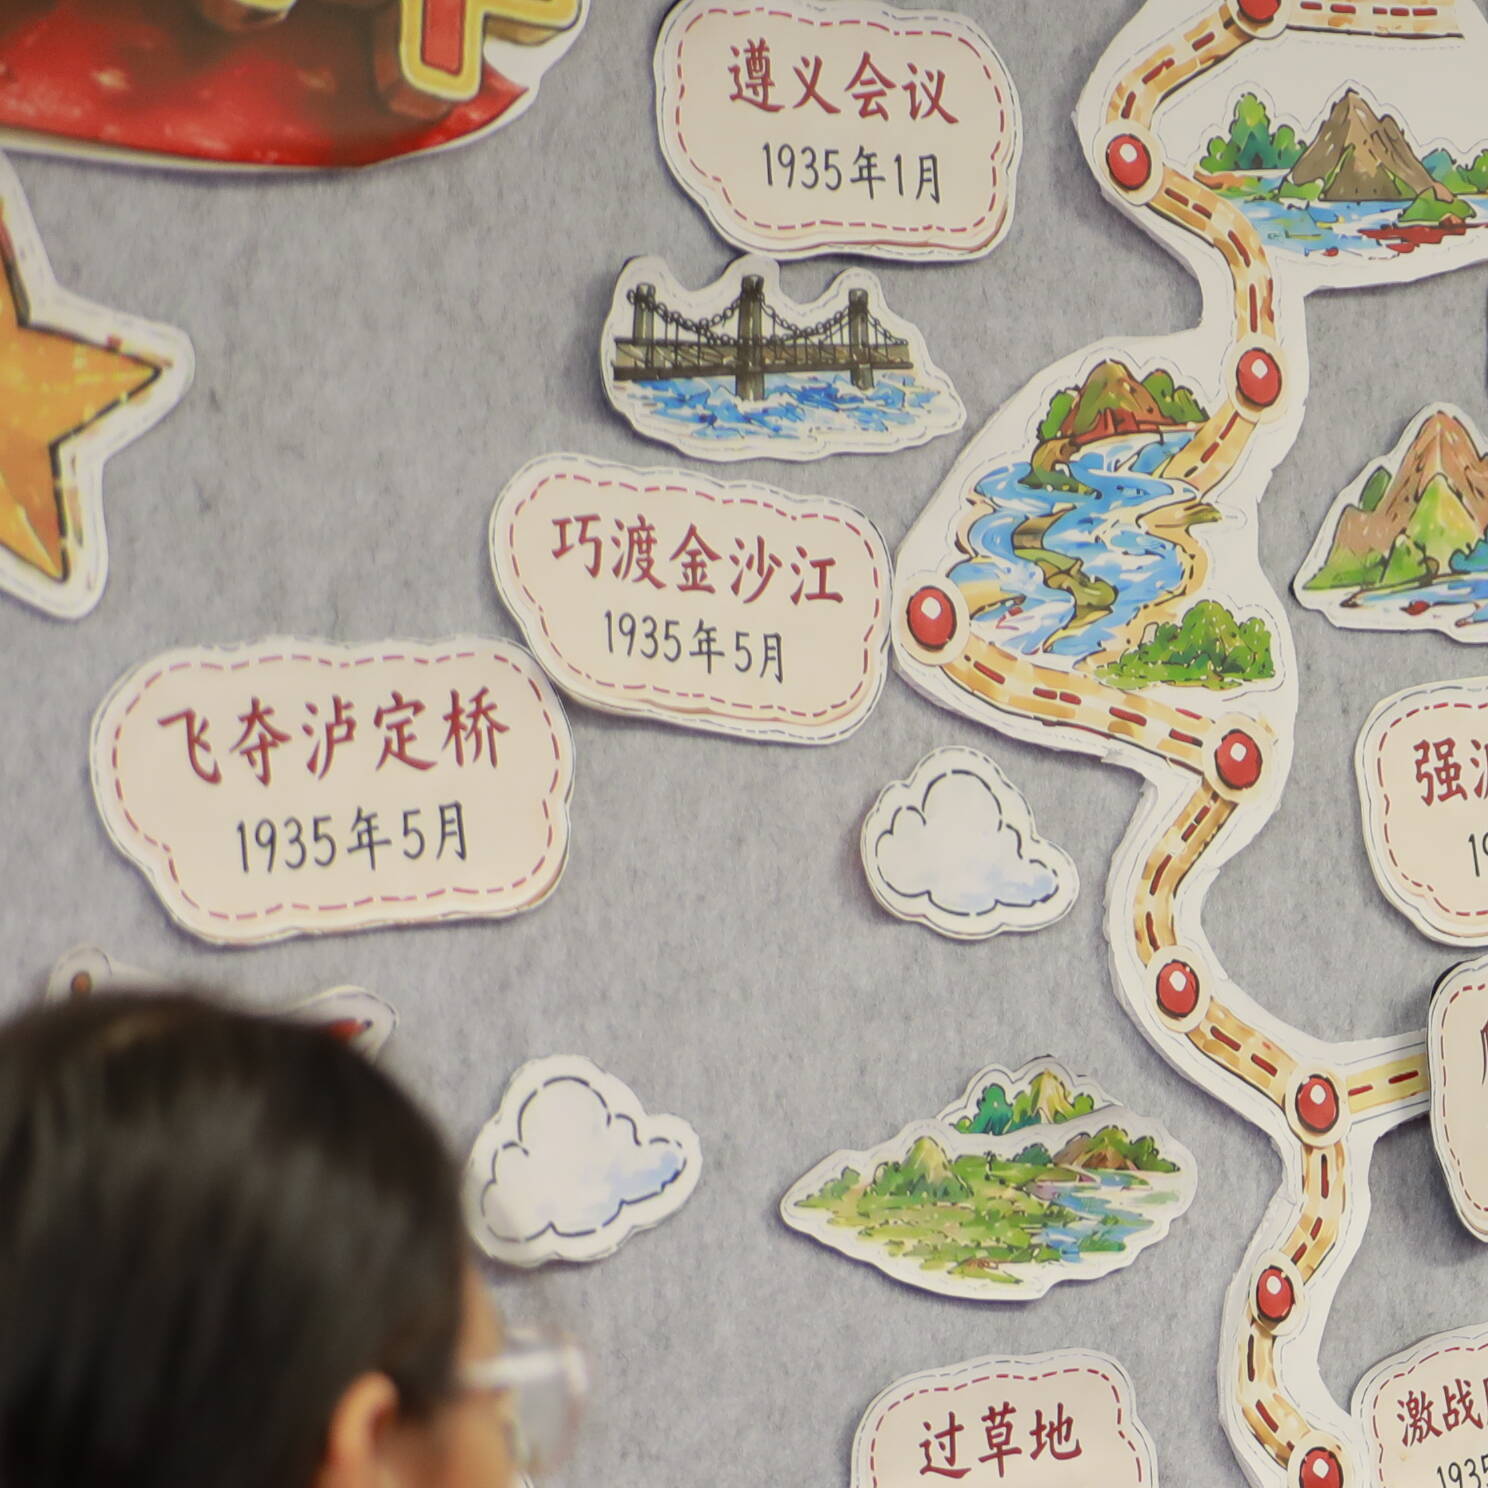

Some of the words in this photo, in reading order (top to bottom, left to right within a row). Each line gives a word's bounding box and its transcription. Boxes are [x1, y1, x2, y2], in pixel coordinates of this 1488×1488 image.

[727, 37, 960, 125] 遵义会议
[761, 142, 941, 204] 1935年1月
[550, 513, 844, 606] 巧渡金沙江
[603, 610, 785, 683] 1935年5月
[156, 685, 511, 787] 飞夺泸定桥
[235, 800, 468, 875] 1935年5月
[918, 1400, 1083, 1480] 过草地
